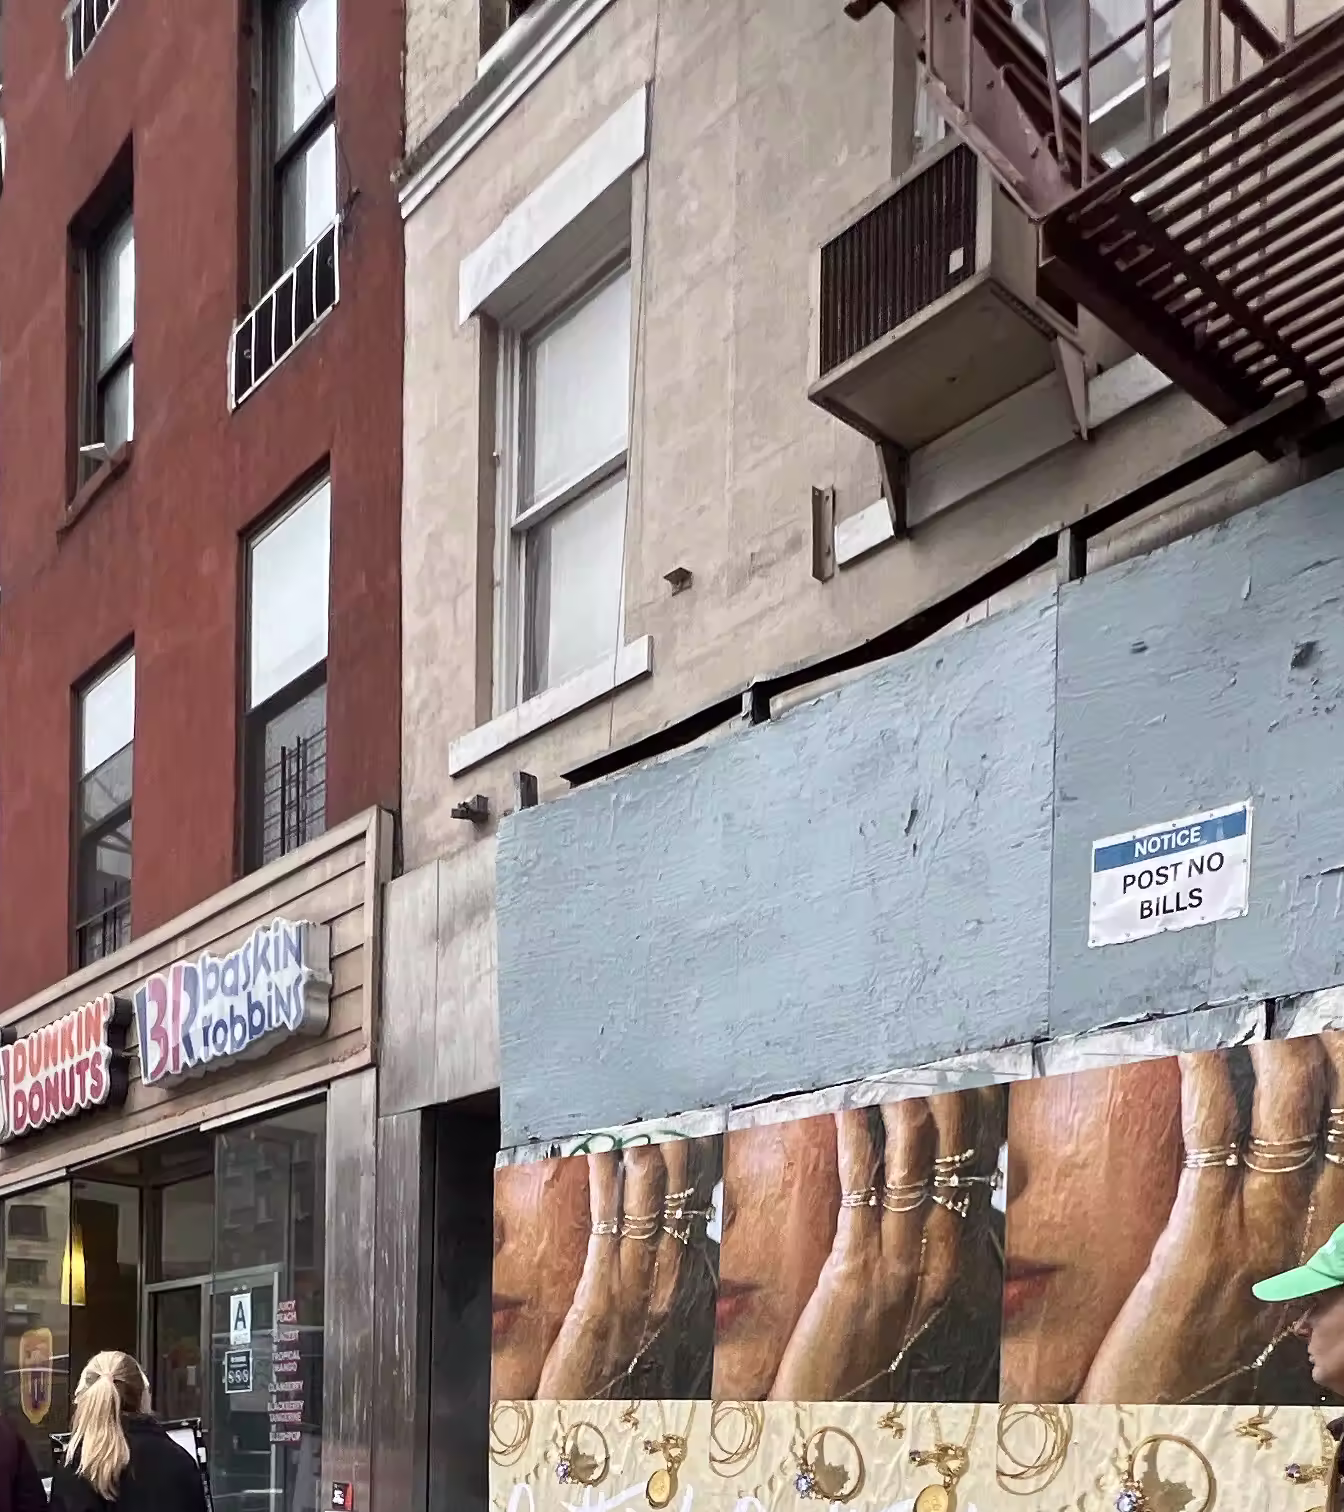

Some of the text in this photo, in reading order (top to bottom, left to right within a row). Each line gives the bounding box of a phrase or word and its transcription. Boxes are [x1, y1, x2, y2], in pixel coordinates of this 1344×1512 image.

[1134, 826, 1202, 858] NOTICE
[1122, 852, 1224, 894] POST NO
[1140, 888, 1203, 920] BILLS
[14, 997, 109, 1084] DUNKIN'
[14, 1051, 103, 1131] DONUTS
[234, 1301, 247, 1330] A
